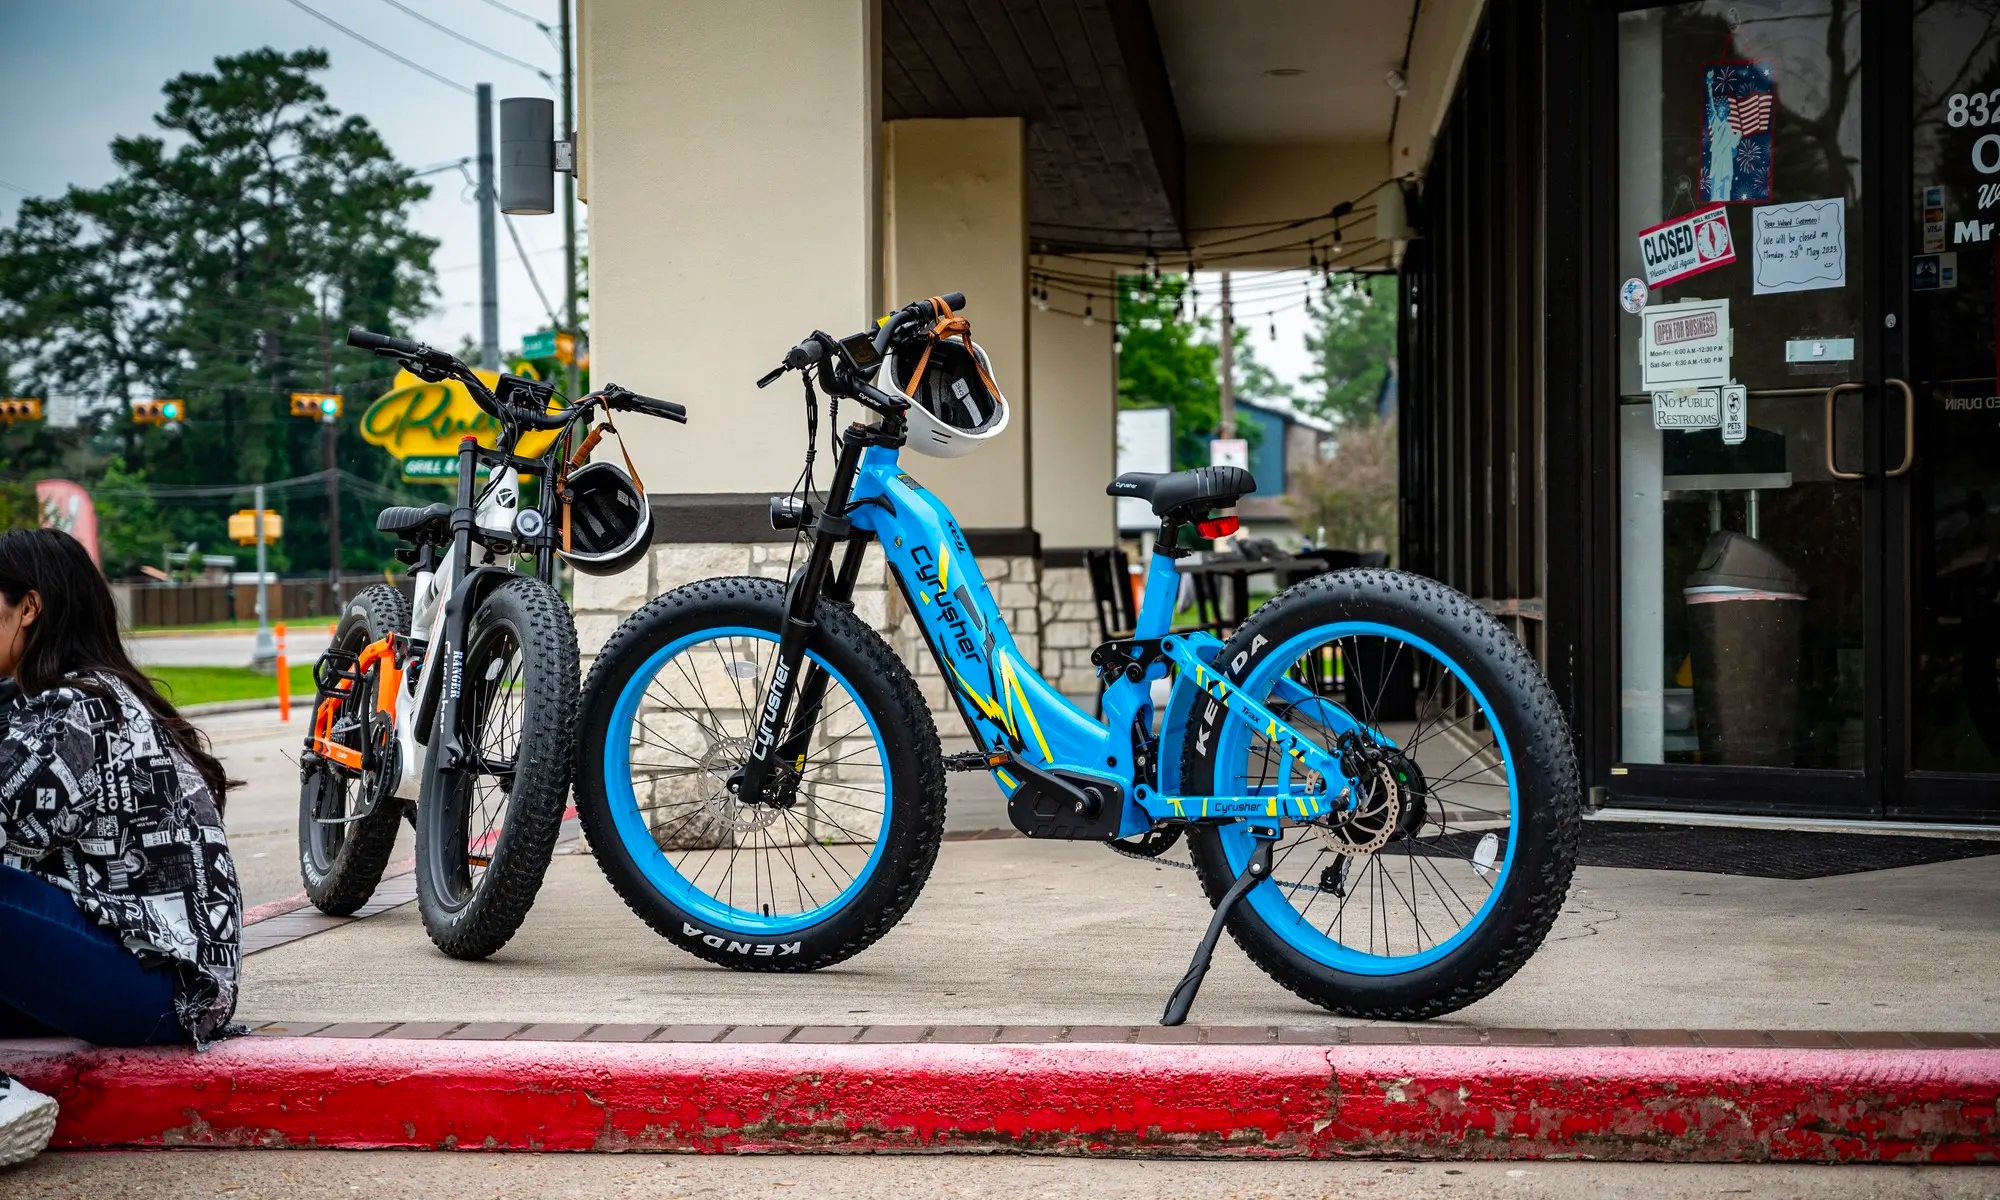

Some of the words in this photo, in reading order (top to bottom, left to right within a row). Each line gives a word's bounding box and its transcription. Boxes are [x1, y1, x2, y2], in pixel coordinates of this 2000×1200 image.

[1947, 88, 2000, 128] 832
[1692, 217, 1704, 225] WILL
[1704, 209, 1725, 220] RETURN
[1927, 224, 1943, 233] VISA
[1643, 224, 1694, 267] CLOSED
[1763, 236, 1773, 245] We
[1775, 233, 1786, 244] will
[1788, 232, 1796, 243] be
[1799, 231, 1817, 243] closed
[1806, 247, 1820, 261] May
[1649, 267, 1668, 279] Please
[1667, 261, 1679, 272] Call
[1679, 256, 1697, 270] Again
[1657, 323, 1673, 342] OPEN
[1673, 320, 1685, 339] FOR
[1685, 315, 1715, 337] BUSINESS
[859, 392, 882, 408] Cyrusher
[1657, 410, 1718, 425] RESTROOMS
[1727, 422, 1742, 430] PETS
[405, 459, 442, 475] GRILL
[1115, 480, 1138, 490] Cyrusher
[910, 544, 983, 665] Cyrusher
[450, 650, 463, 699] RANGER
[752, 654, 792, 762] Cyrusher
[1242, 705, 1260, 723] Trax
[103, 761, 119, 811] TOMO
[118, 775, 134, 814] NEW
[1214, 802, 1262, 814] Cyrusher
[20, 824, 36, 839] key
[682, 921, 802, 957] KENDA
